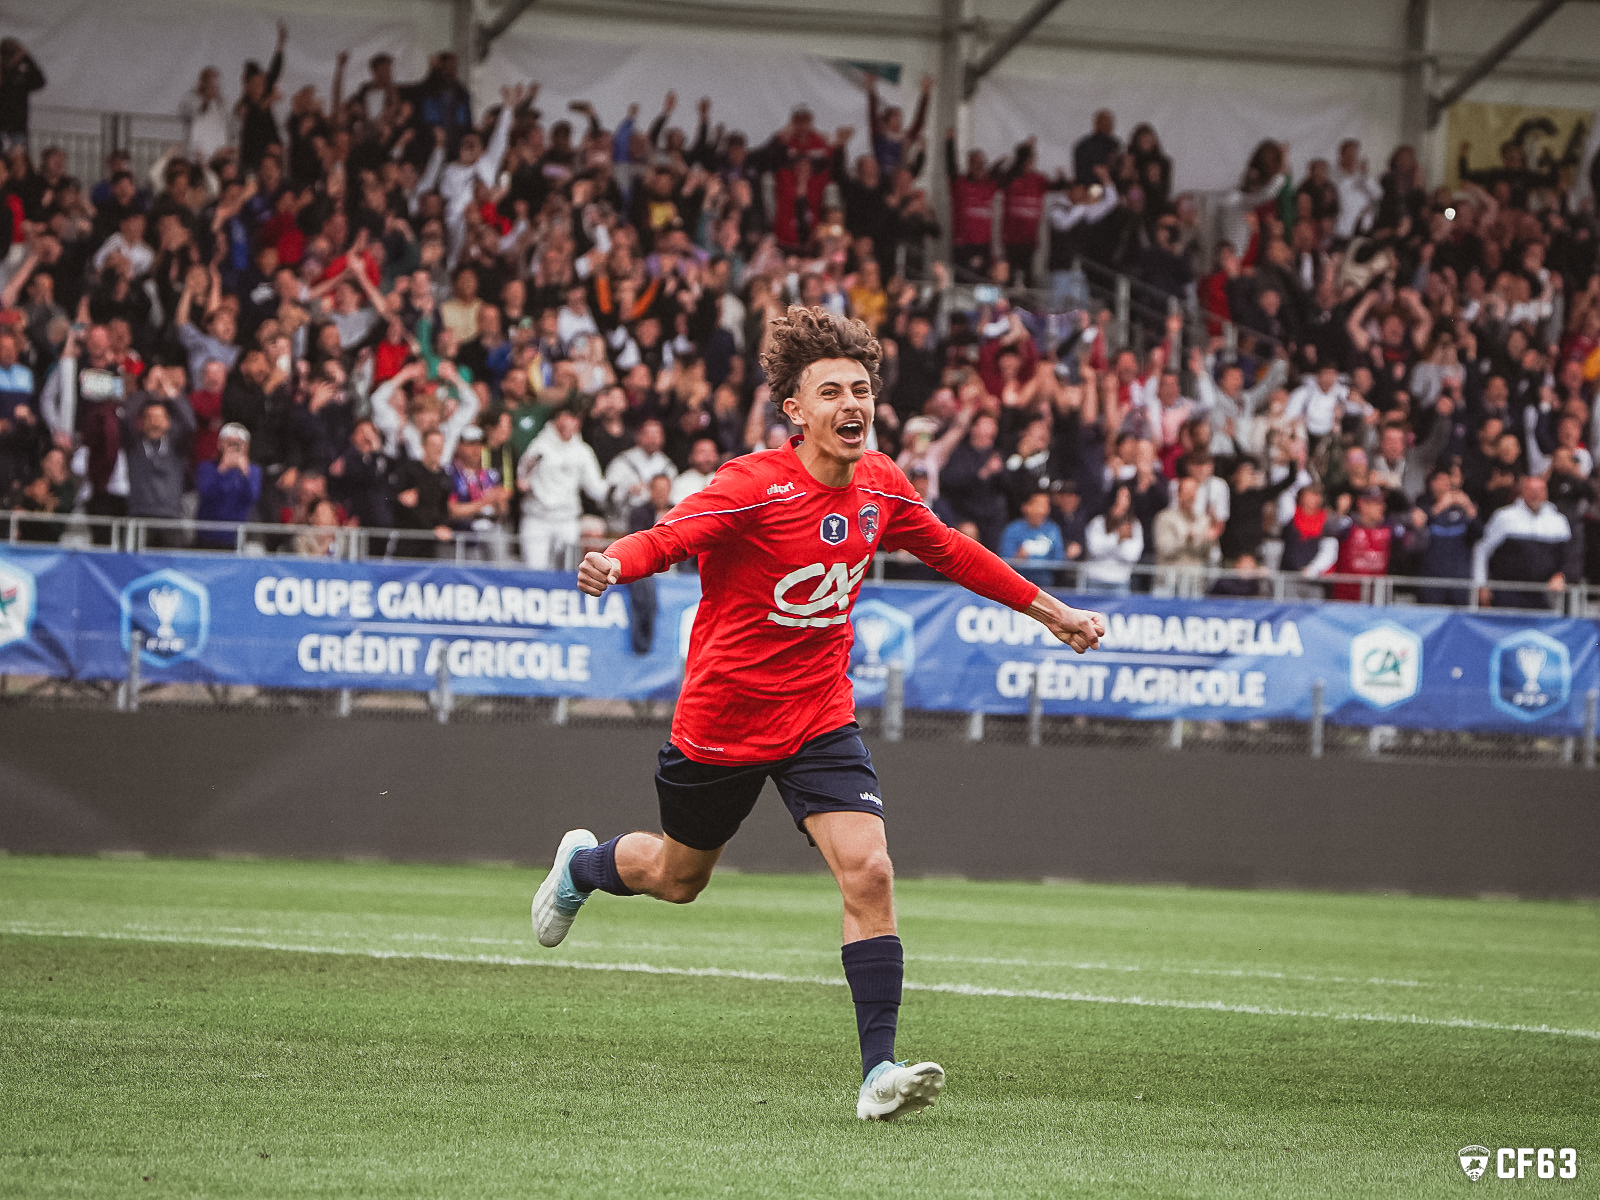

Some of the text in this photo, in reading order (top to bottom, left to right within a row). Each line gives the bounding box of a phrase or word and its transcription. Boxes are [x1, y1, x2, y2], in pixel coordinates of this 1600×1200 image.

[254, 576, 630, 629] COUPE GAMBARDELLA
[297, 629, 421, 676] CRÉDIT
[1098, 611, 1304, 657] AMBARDELLA
[1110, 666, 1267, 708] AGRICOLE
